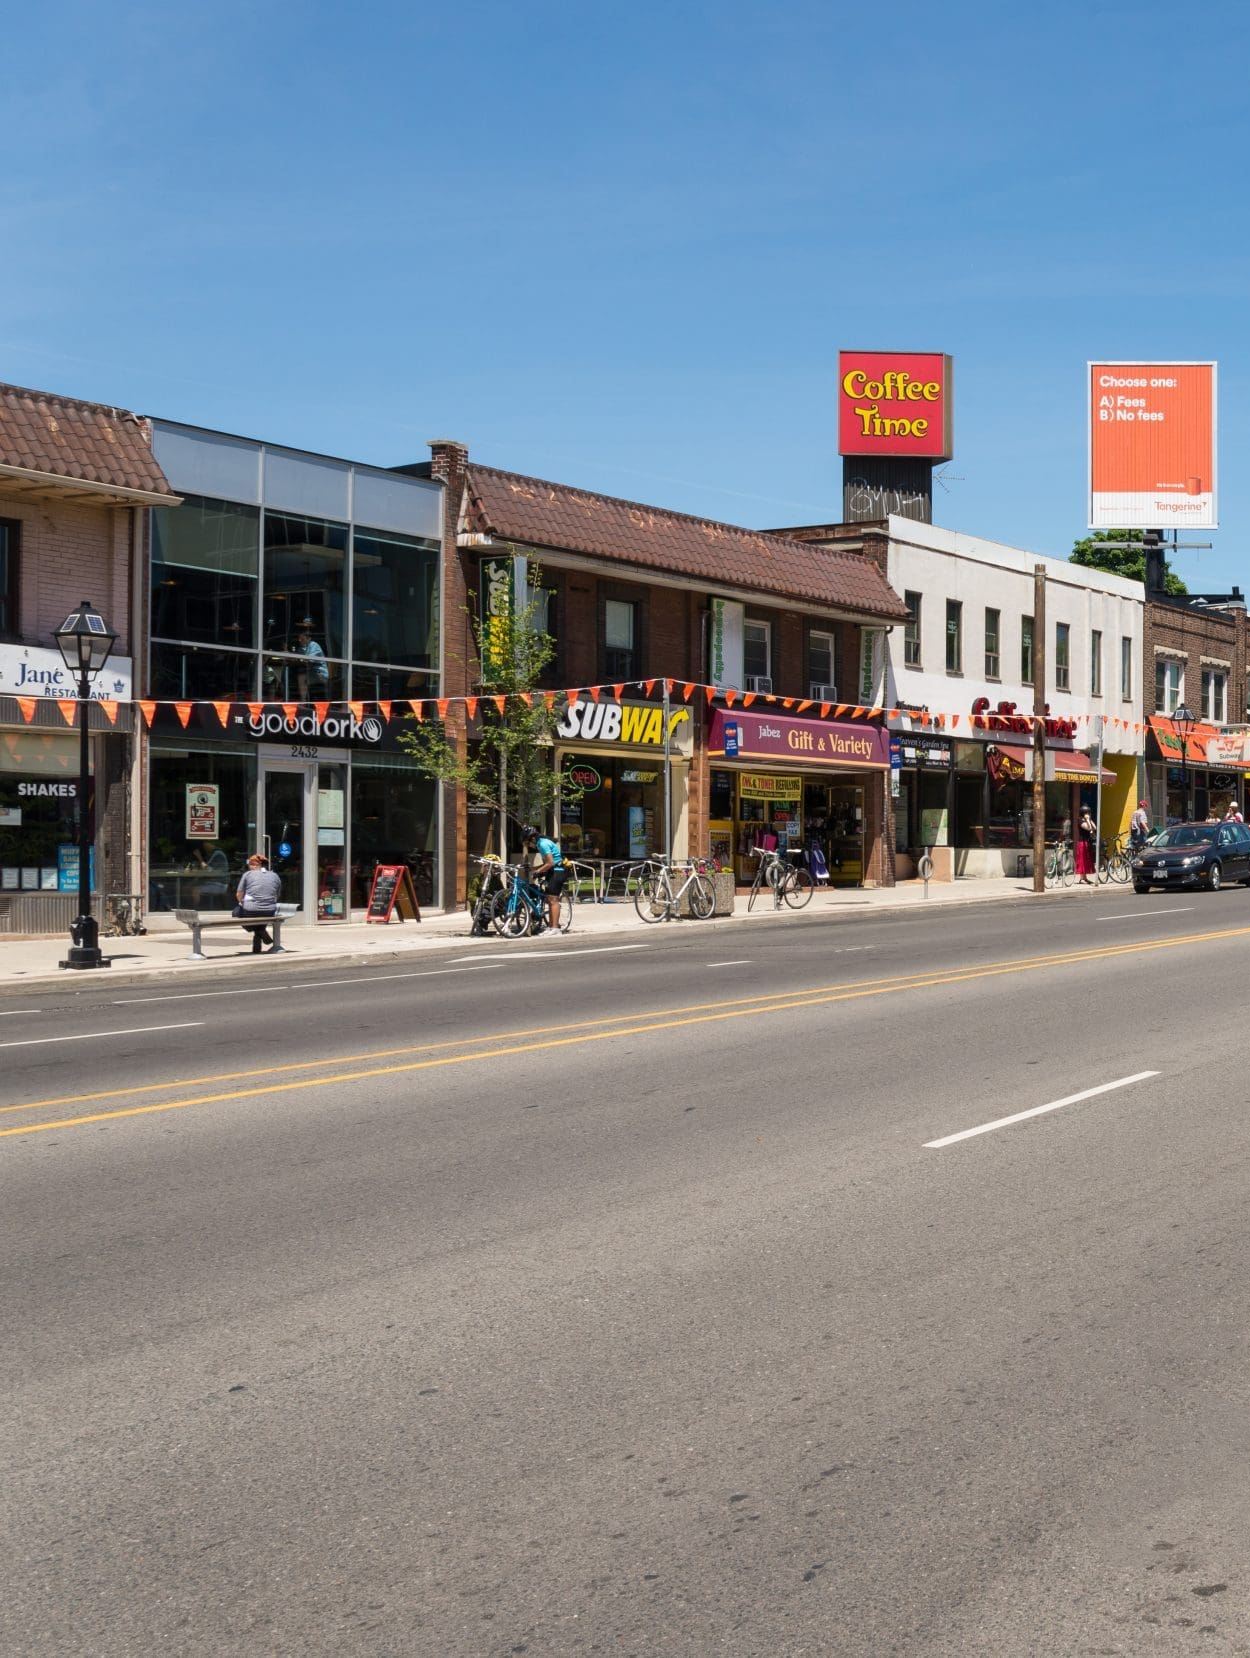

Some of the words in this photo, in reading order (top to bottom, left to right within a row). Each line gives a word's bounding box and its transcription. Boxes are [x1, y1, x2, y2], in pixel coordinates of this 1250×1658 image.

[843, 370, 941, 401] Coffee
[1099, 375, 1148, 388] Choose
[1150, 378, 1178, 388] one:
[1099, 395, 1115, 409] A)
[1117, 395, 1147, 408] Fees
[854, 404, 929, 438] Time
[1099, 409, 1115, 421] B)
[1116, 409, 1135, 421] No
[1137, 409, 1165, 421] fees
[1154, 501, 1202, 512] Tangerine
[14, 662, 64, 687] Jane
[44, 687, 111, 700] RESTAANT
[234, 716, 243, 724] THE
[758, 724, 781, 739] Jabez
[787, 729, 814, 750] Gift
[817, 737, 826, 752] &
[828, 733, 873, 760] Variety
[921, 740, 940, 749] Garden
[291, 745, 318, 759] 2432
[572, 770, 597, 785] OPEN
[18, 783, 77, 797] SHAKES
